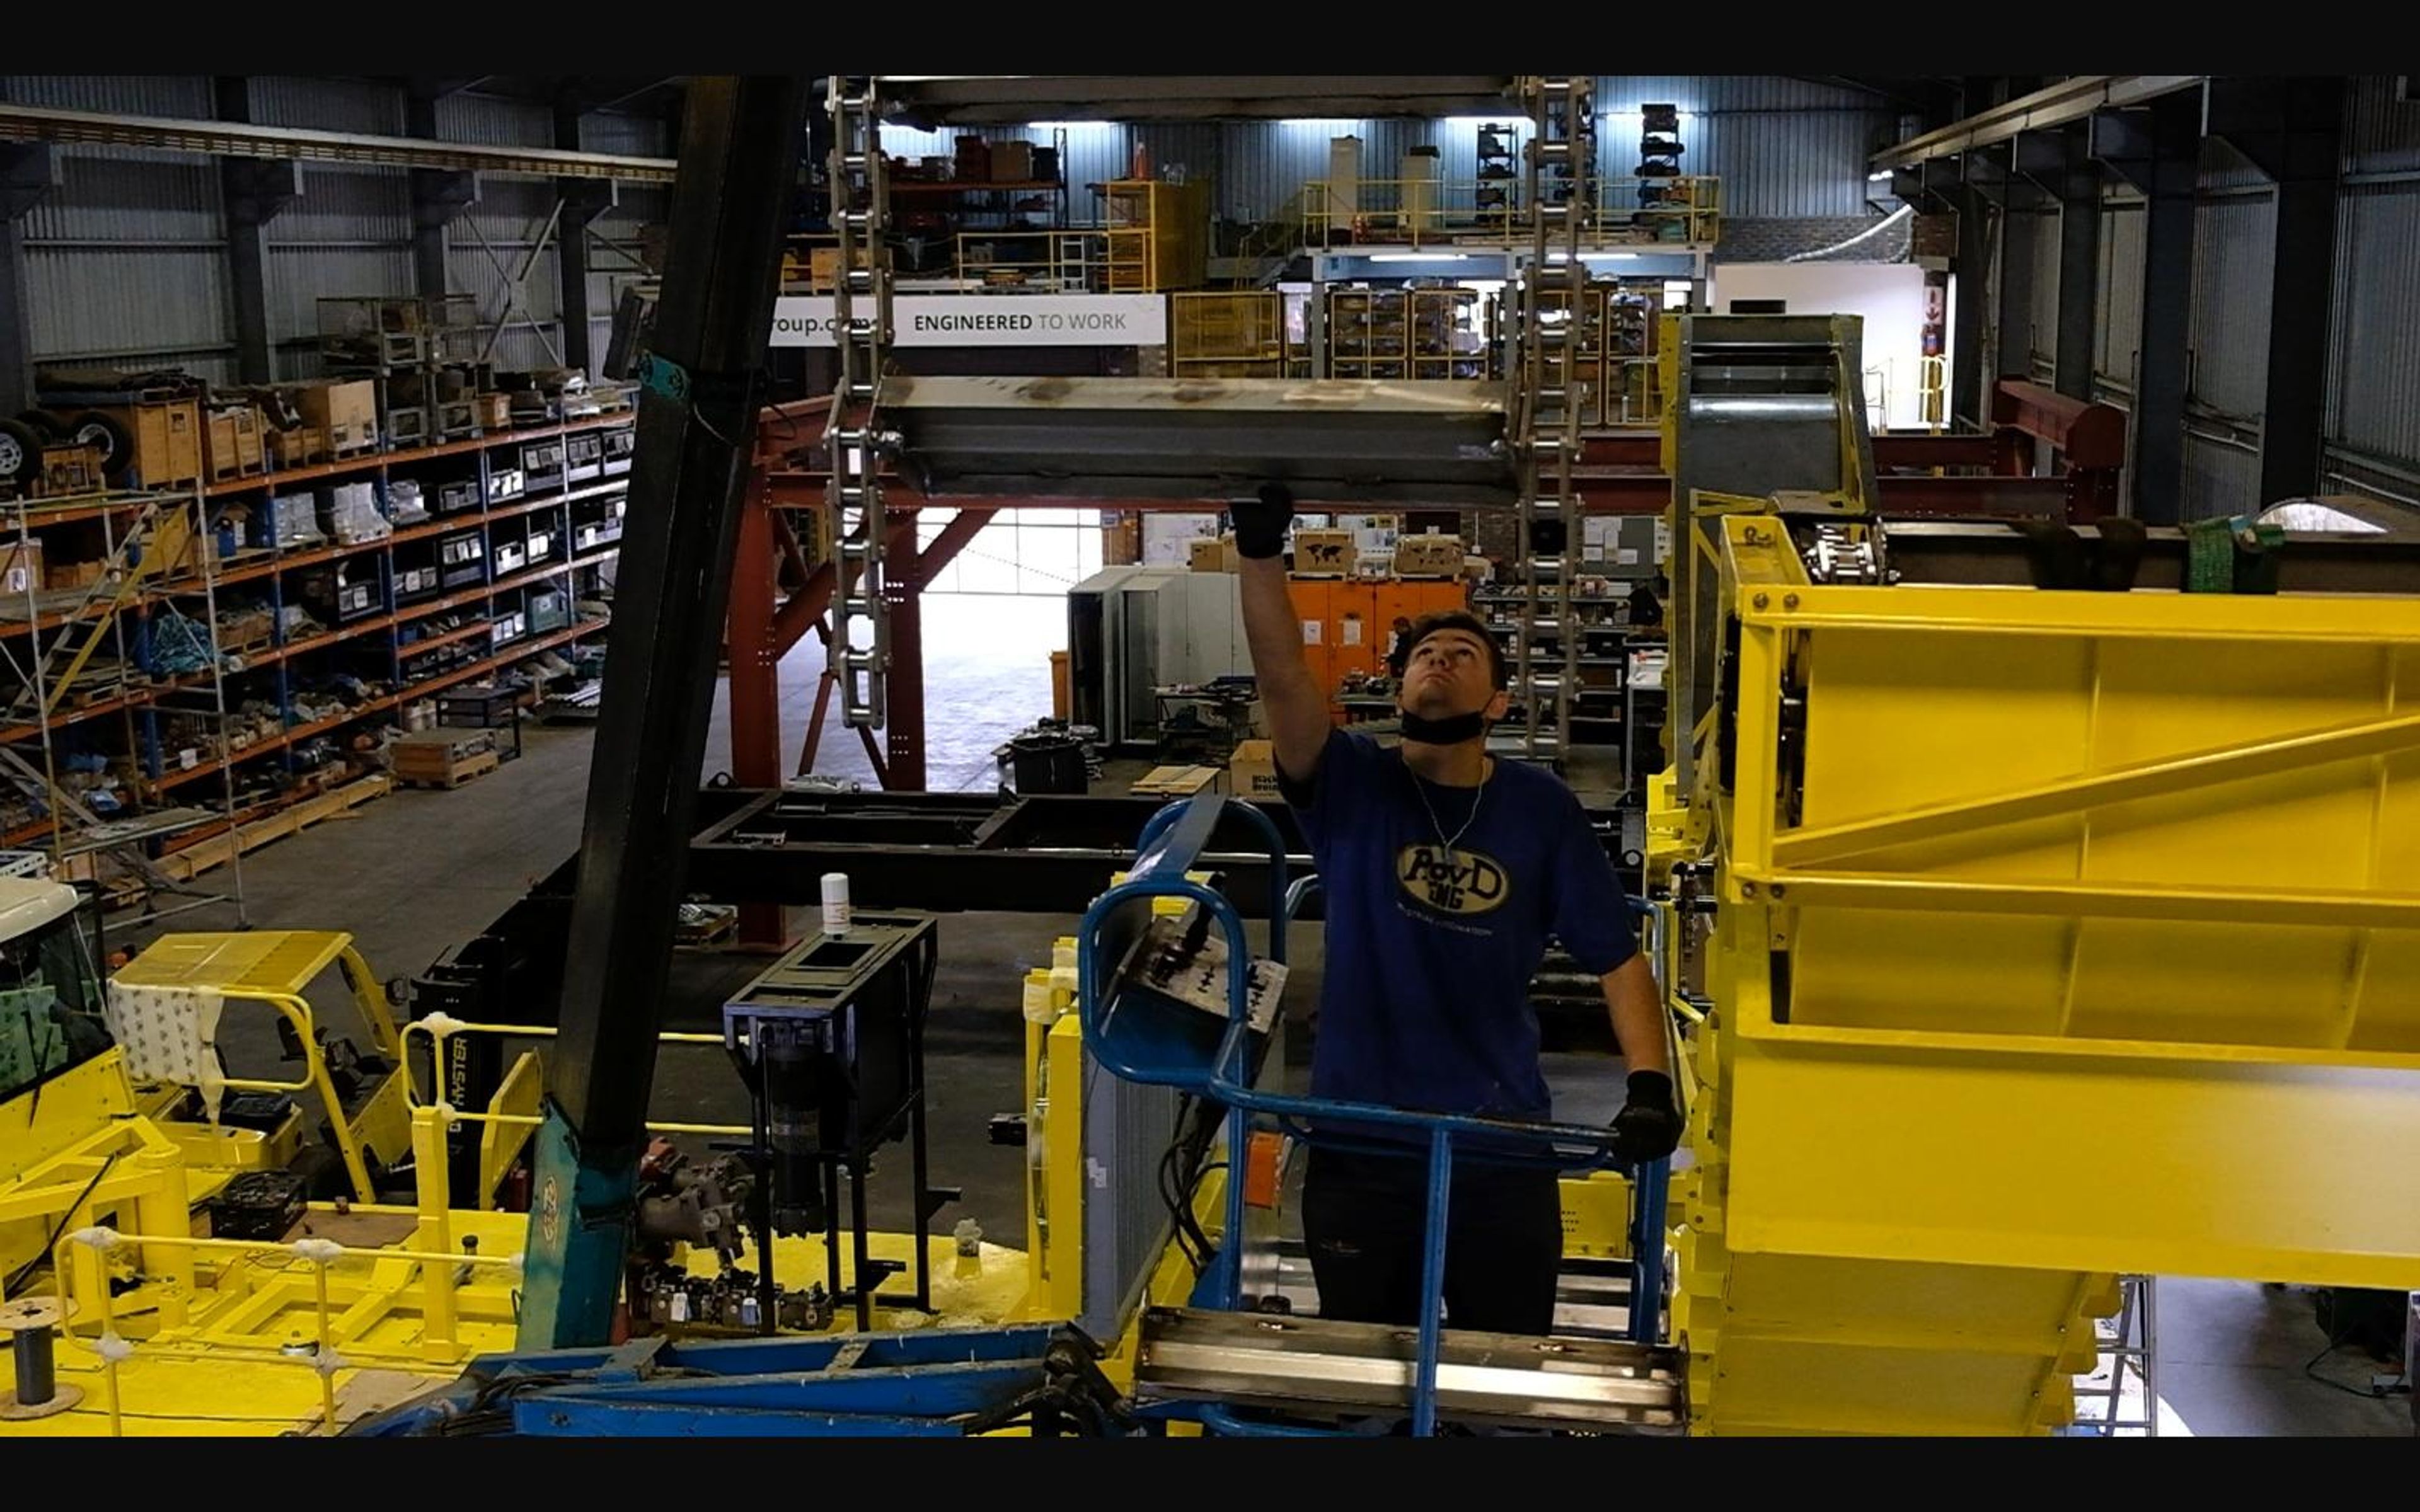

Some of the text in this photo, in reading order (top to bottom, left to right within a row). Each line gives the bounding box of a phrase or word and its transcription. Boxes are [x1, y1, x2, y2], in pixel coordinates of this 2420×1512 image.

[914, 313, 1127, 331] ENGINEERED TO WORK
[452, 1036, 468, 1106] HYSTER
